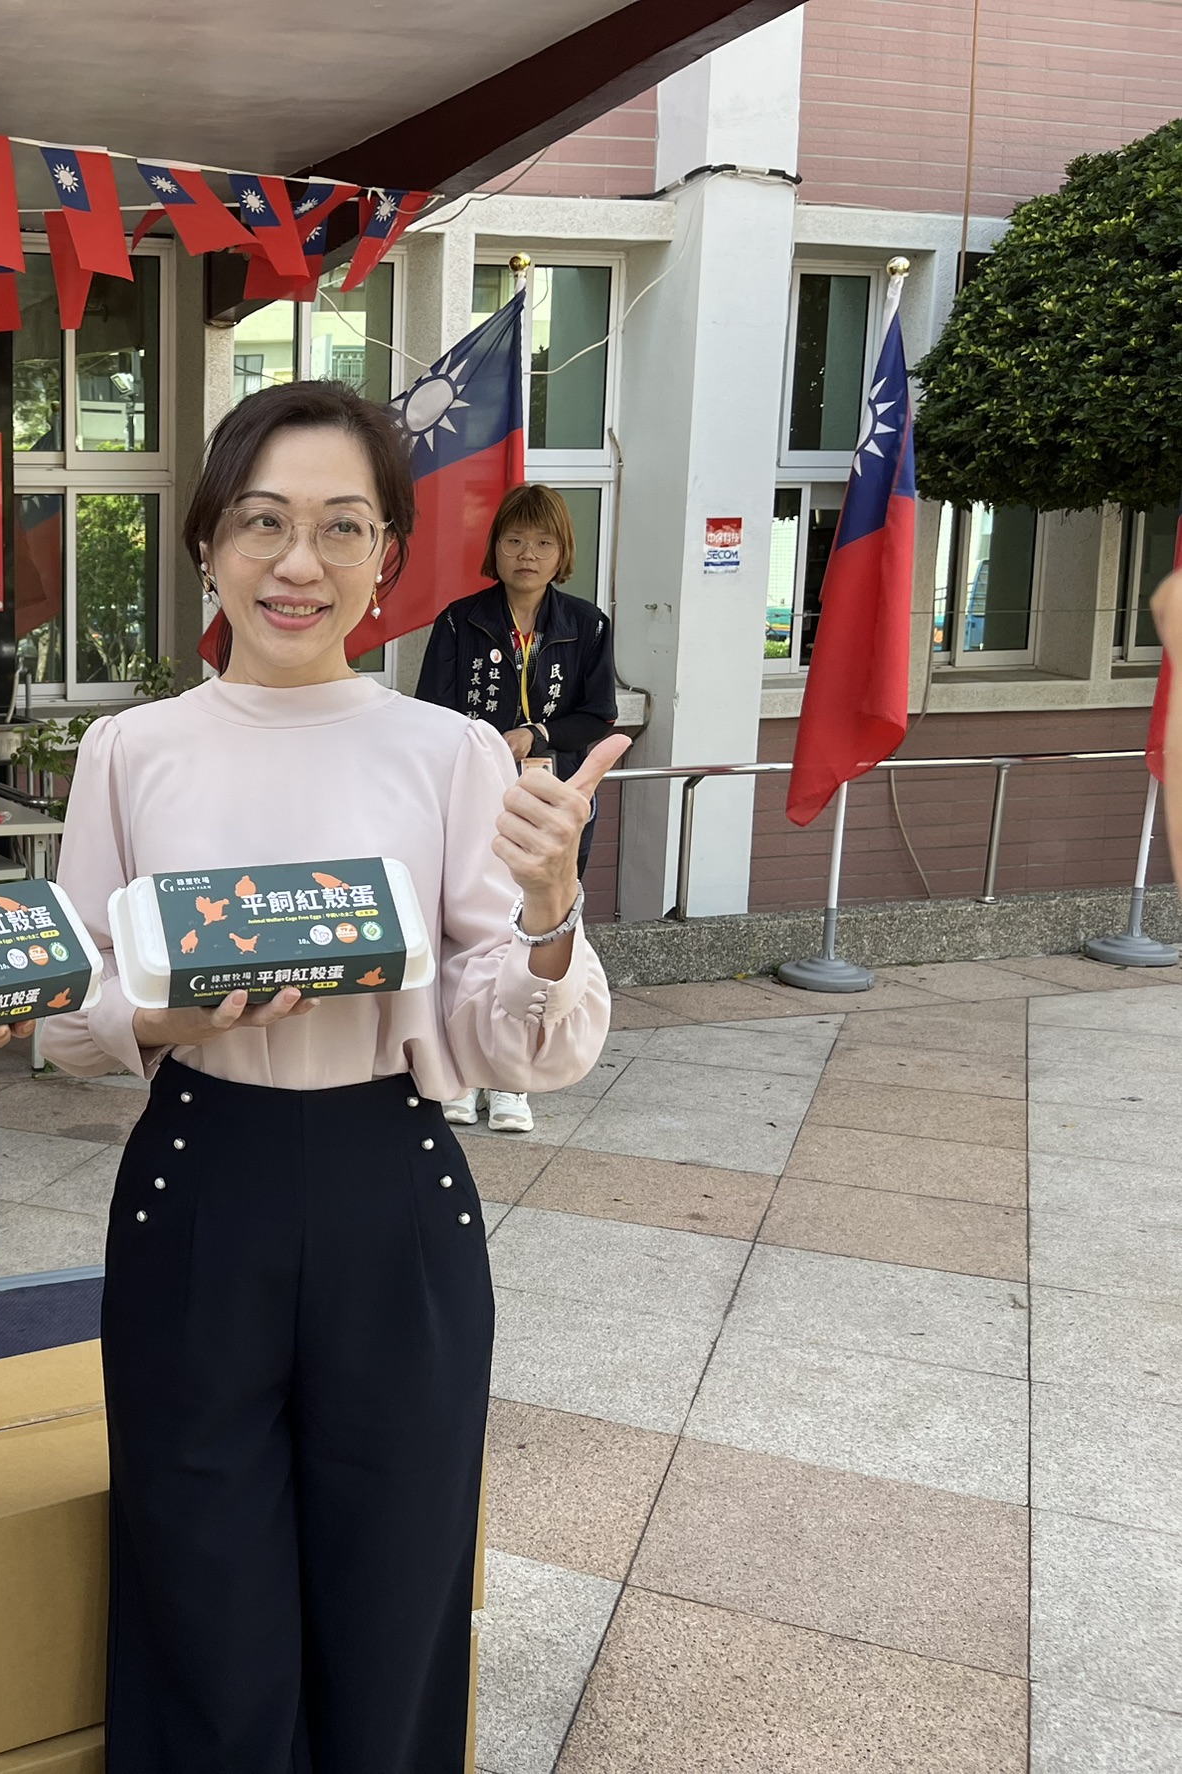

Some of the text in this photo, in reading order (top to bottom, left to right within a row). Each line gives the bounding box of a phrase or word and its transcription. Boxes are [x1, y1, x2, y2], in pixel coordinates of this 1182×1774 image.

[707, 550, 738, 560] SECOM
[485, 668, 502, 712] 社會課
[241, 885, 377, 915] 平飼紅殼蛋
[257, 965, 345, 984] 平飼紅殼蛋
